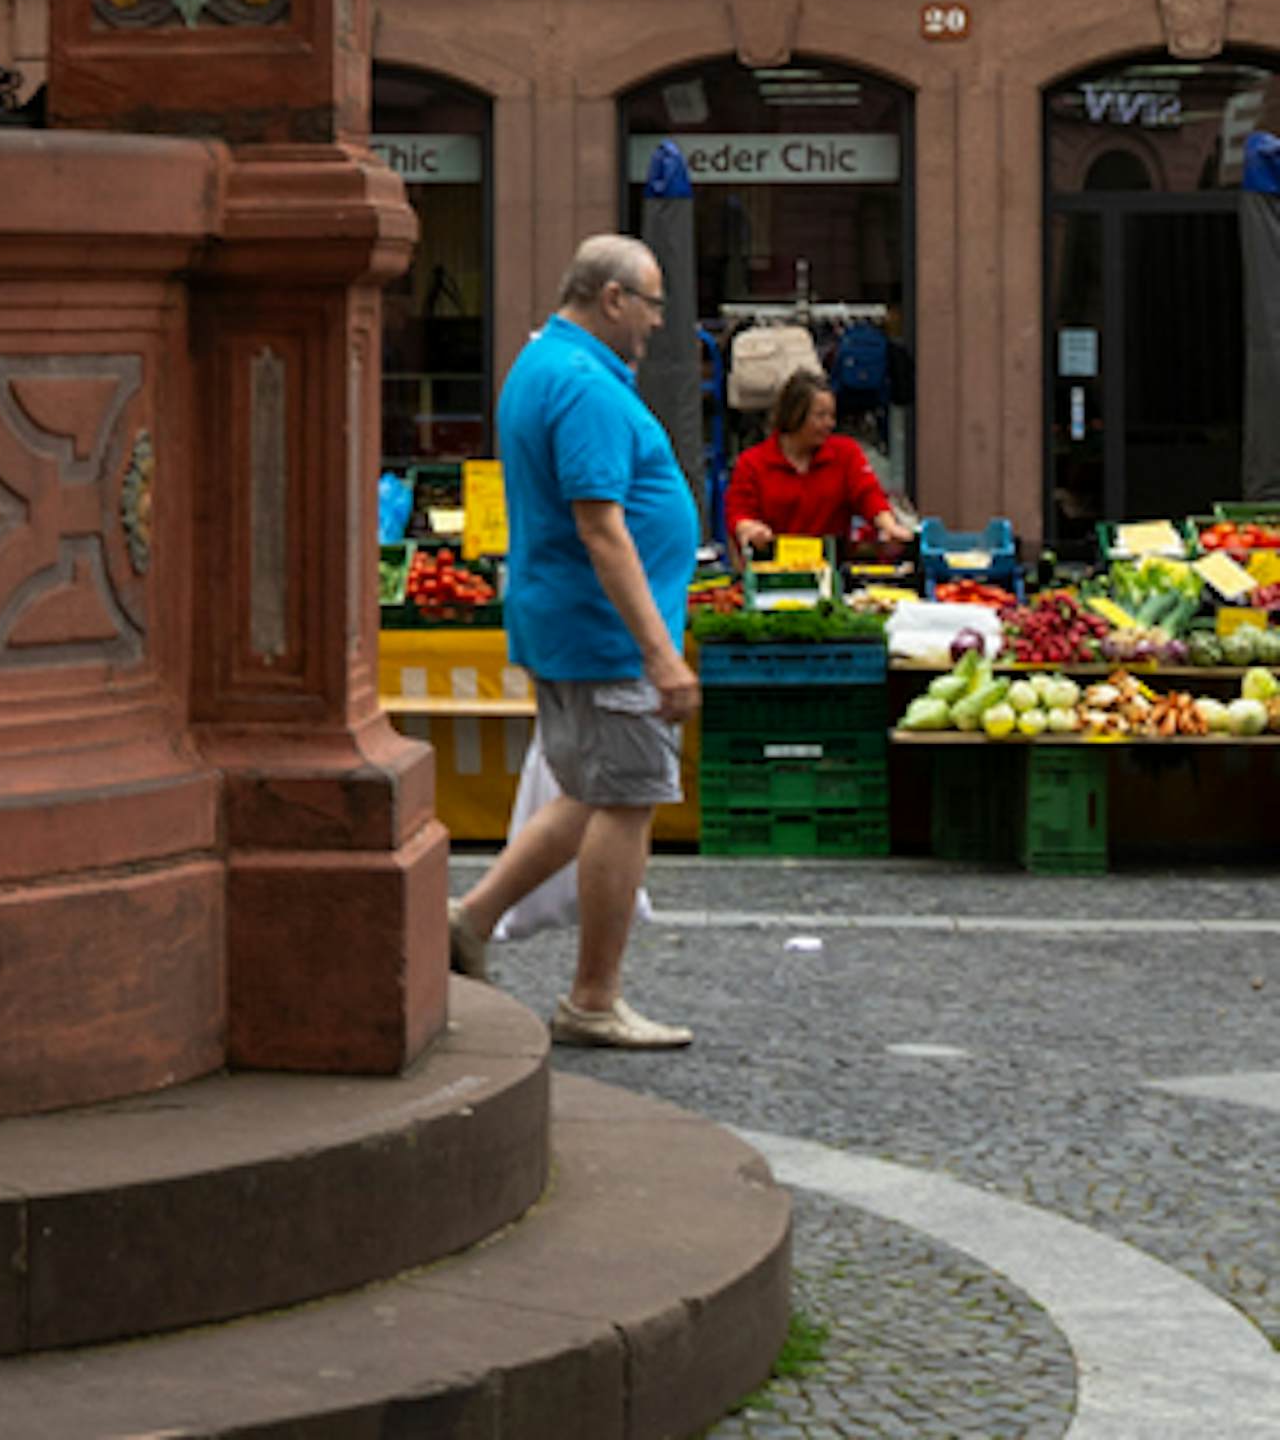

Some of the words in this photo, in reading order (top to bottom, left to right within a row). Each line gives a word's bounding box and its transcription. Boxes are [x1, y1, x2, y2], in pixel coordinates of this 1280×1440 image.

[924, 7, 966, 33] 20
[688, 144, 771, 172] eder
[781, 142, 857, 173] Chic
